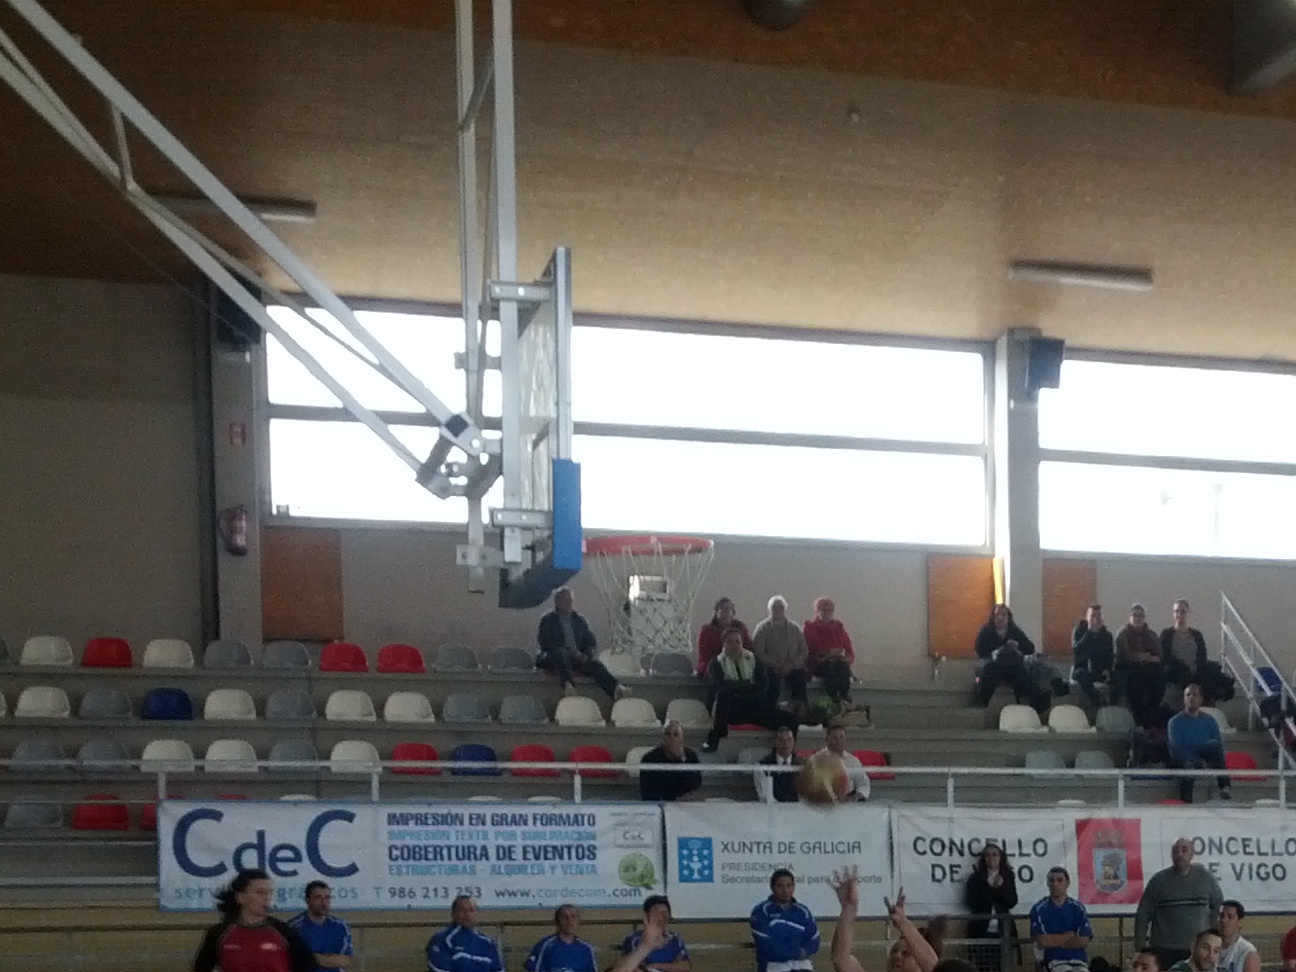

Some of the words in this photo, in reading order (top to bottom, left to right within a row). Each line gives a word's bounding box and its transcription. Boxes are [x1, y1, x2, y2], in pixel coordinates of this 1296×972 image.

[387, 808, 464, 826] IMPRESIÓN
[469, 812, 486, 826] EN
[491, 812, 528, 827] GRAN
[532, 812, 596, 827] FORMATO
[173, 808, 359, 878] CdeC
[388, 843, 489, 861] COBERTURA
[495, 843, 516, 861] DE
[522, 843, 597, 861] EVENTOS
[721, 841, 772, 855] XUNTA
[777, 841, 796, 855] DE
[800, 841, 862, 855] GALICIA
[912, 835, 1048, 858] CONCLLO
[721, 862, 795, 872] PRESIDENCIA
[931, 863, 962, 884] DE
[1231, 863, 1287, 882] VIGO
[388, 886, 416, 899] 986
[421, 886, 449, 899] 213
[455, 886, 482, 899] 253
